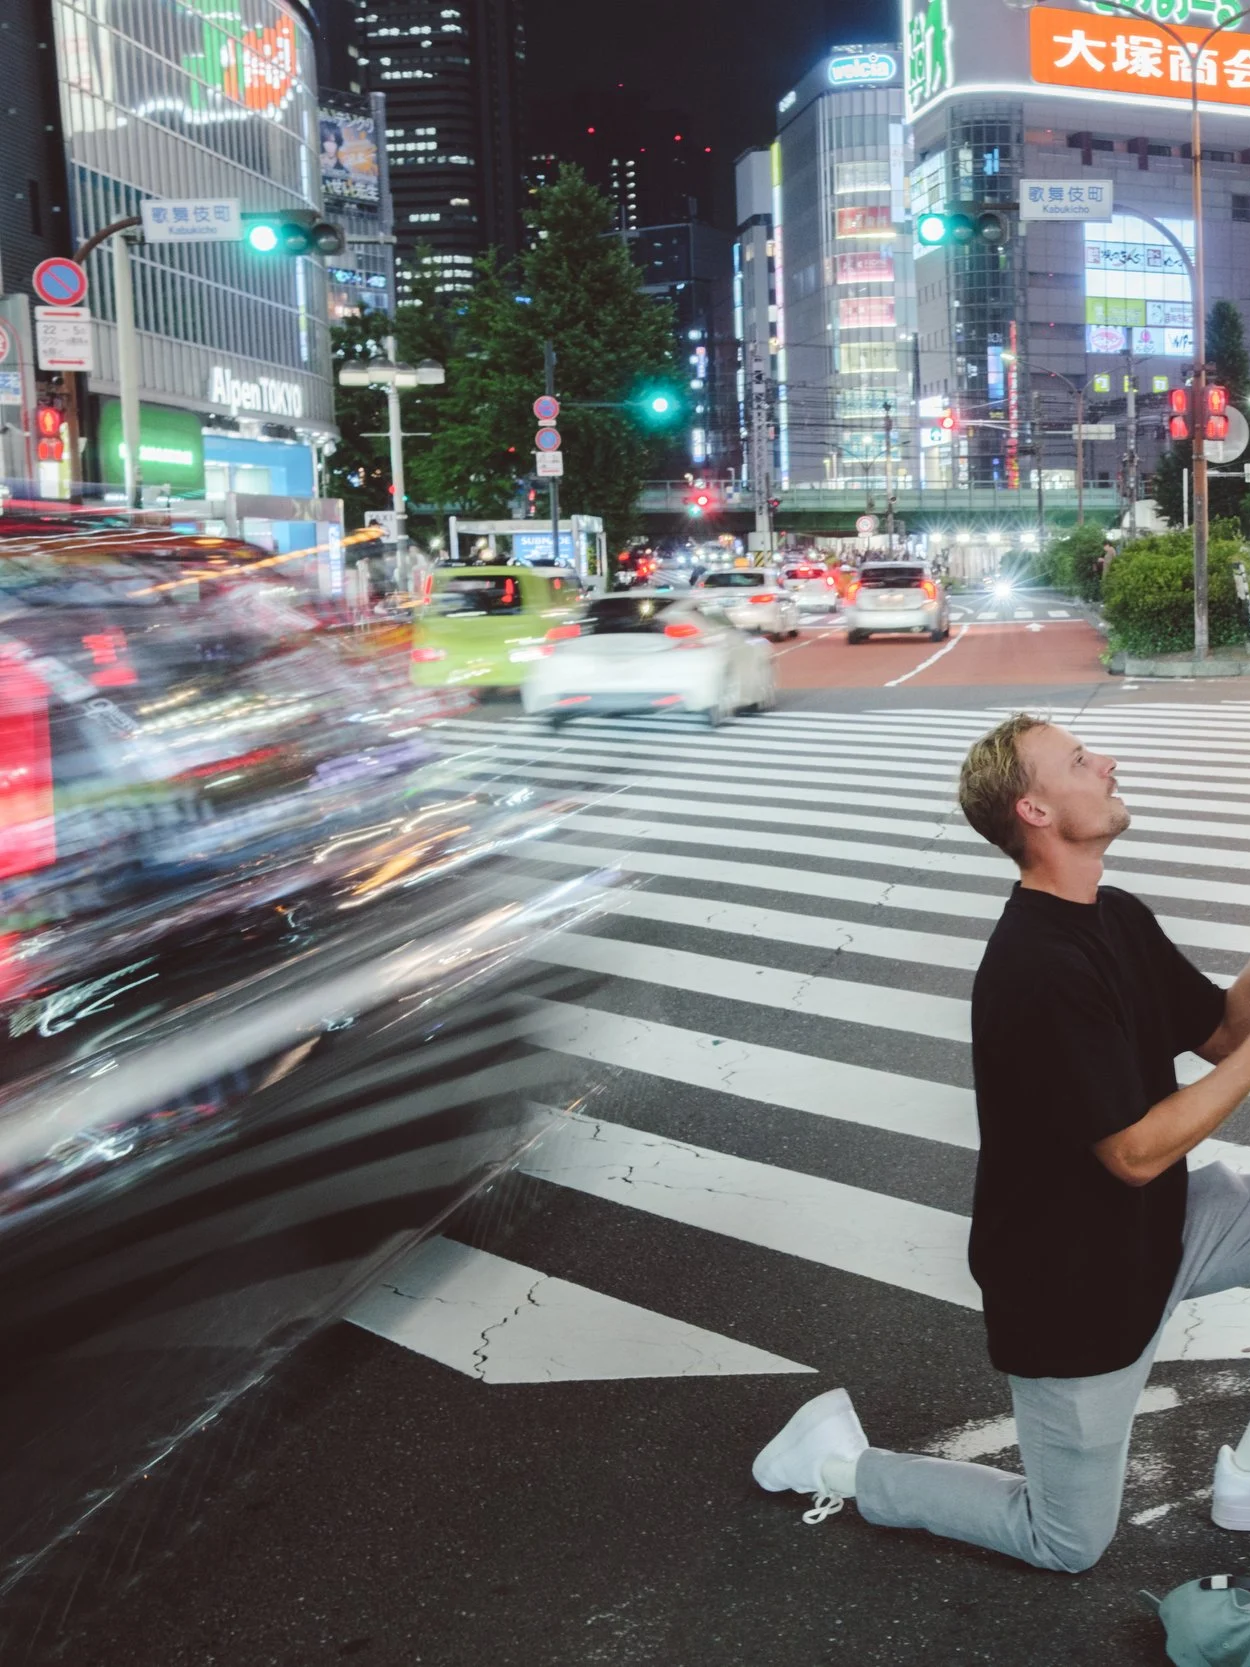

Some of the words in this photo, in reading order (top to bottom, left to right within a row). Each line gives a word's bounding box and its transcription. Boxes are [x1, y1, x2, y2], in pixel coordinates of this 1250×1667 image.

[832, 55, 890, 81] welcia
[1028, 186, 1104, 203] 歌舞伎町
[151, 205, 231, 224] 歌舞伎町
[1043, 204, 1090, 215] Kabukicho
[168, 225, 218, 236] Kabukicho
[520, 536, 571, 546] SUBNDE
